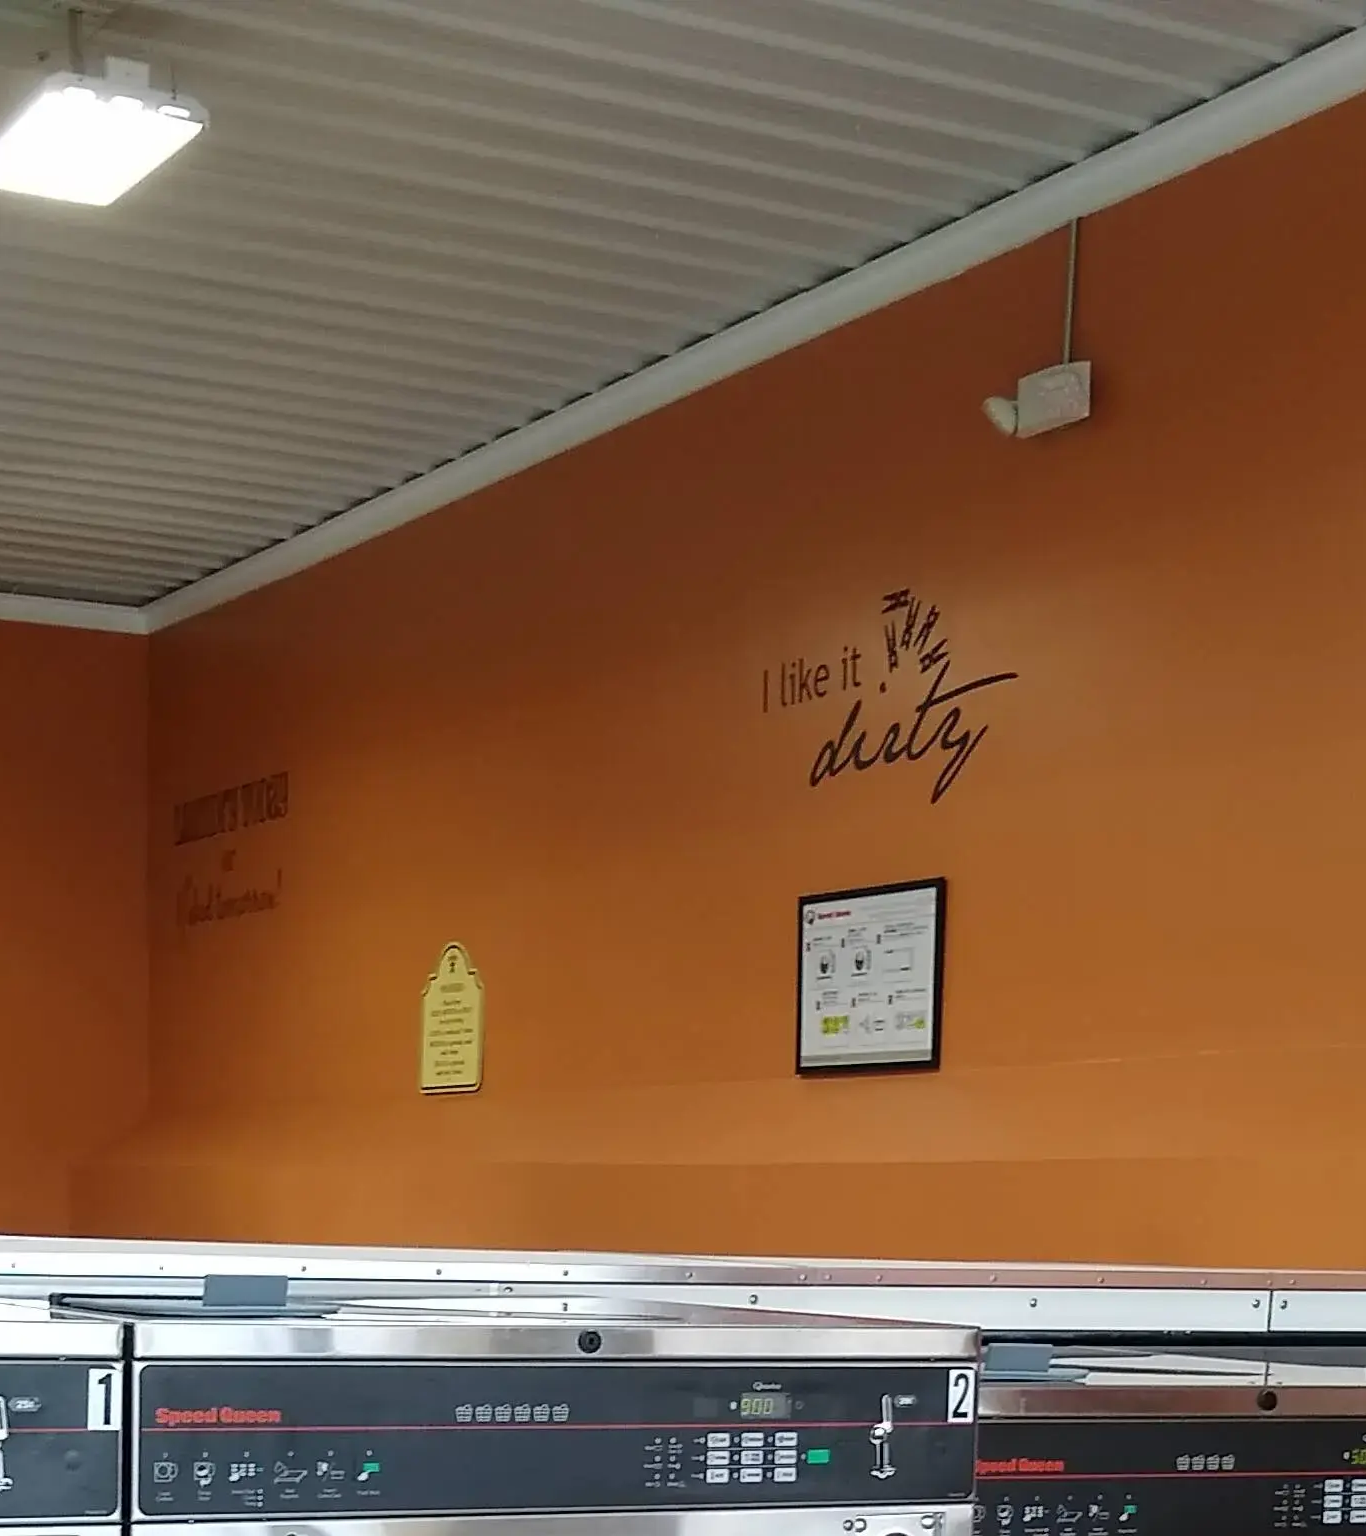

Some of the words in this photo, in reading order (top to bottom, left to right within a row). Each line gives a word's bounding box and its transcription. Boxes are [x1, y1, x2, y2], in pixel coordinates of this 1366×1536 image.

[762, 669, 770, 713] I
[779, 661, 831, 709] like
[840, 645, 862, 692] it
[808, 660, 1020, 805] dirty
[97, 1373, 113, 1426] 1
[155, 1406, 218, 1427] Speed
[219, 1406, 282, 1423] Queen
[952, 1372, 970, 1419] 2
[1018, 1457, 1065, 1472] Queen
